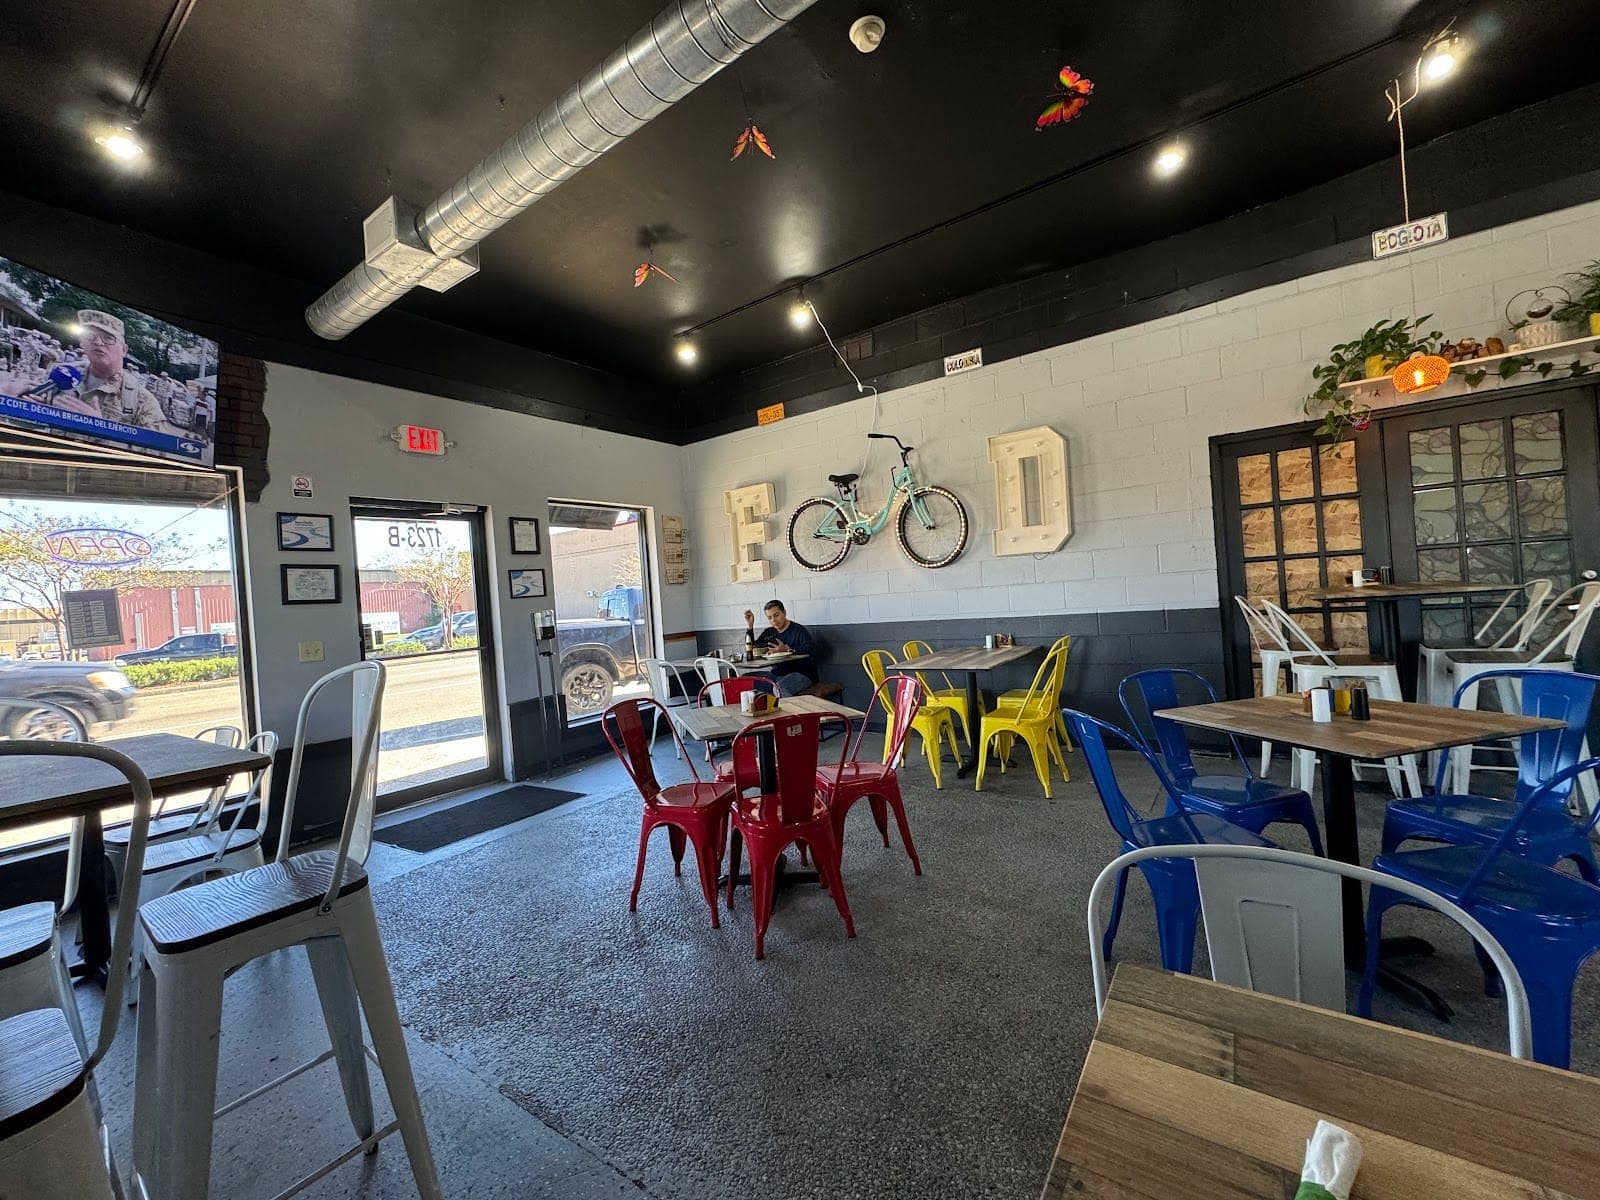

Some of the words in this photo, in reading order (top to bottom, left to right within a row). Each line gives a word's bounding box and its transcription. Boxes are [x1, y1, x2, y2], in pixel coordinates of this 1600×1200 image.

[62, 411, 94, 427] BRIGADA
[94, 419, 108, 430] DEL
[408, 426, 439, 453] EXIT
